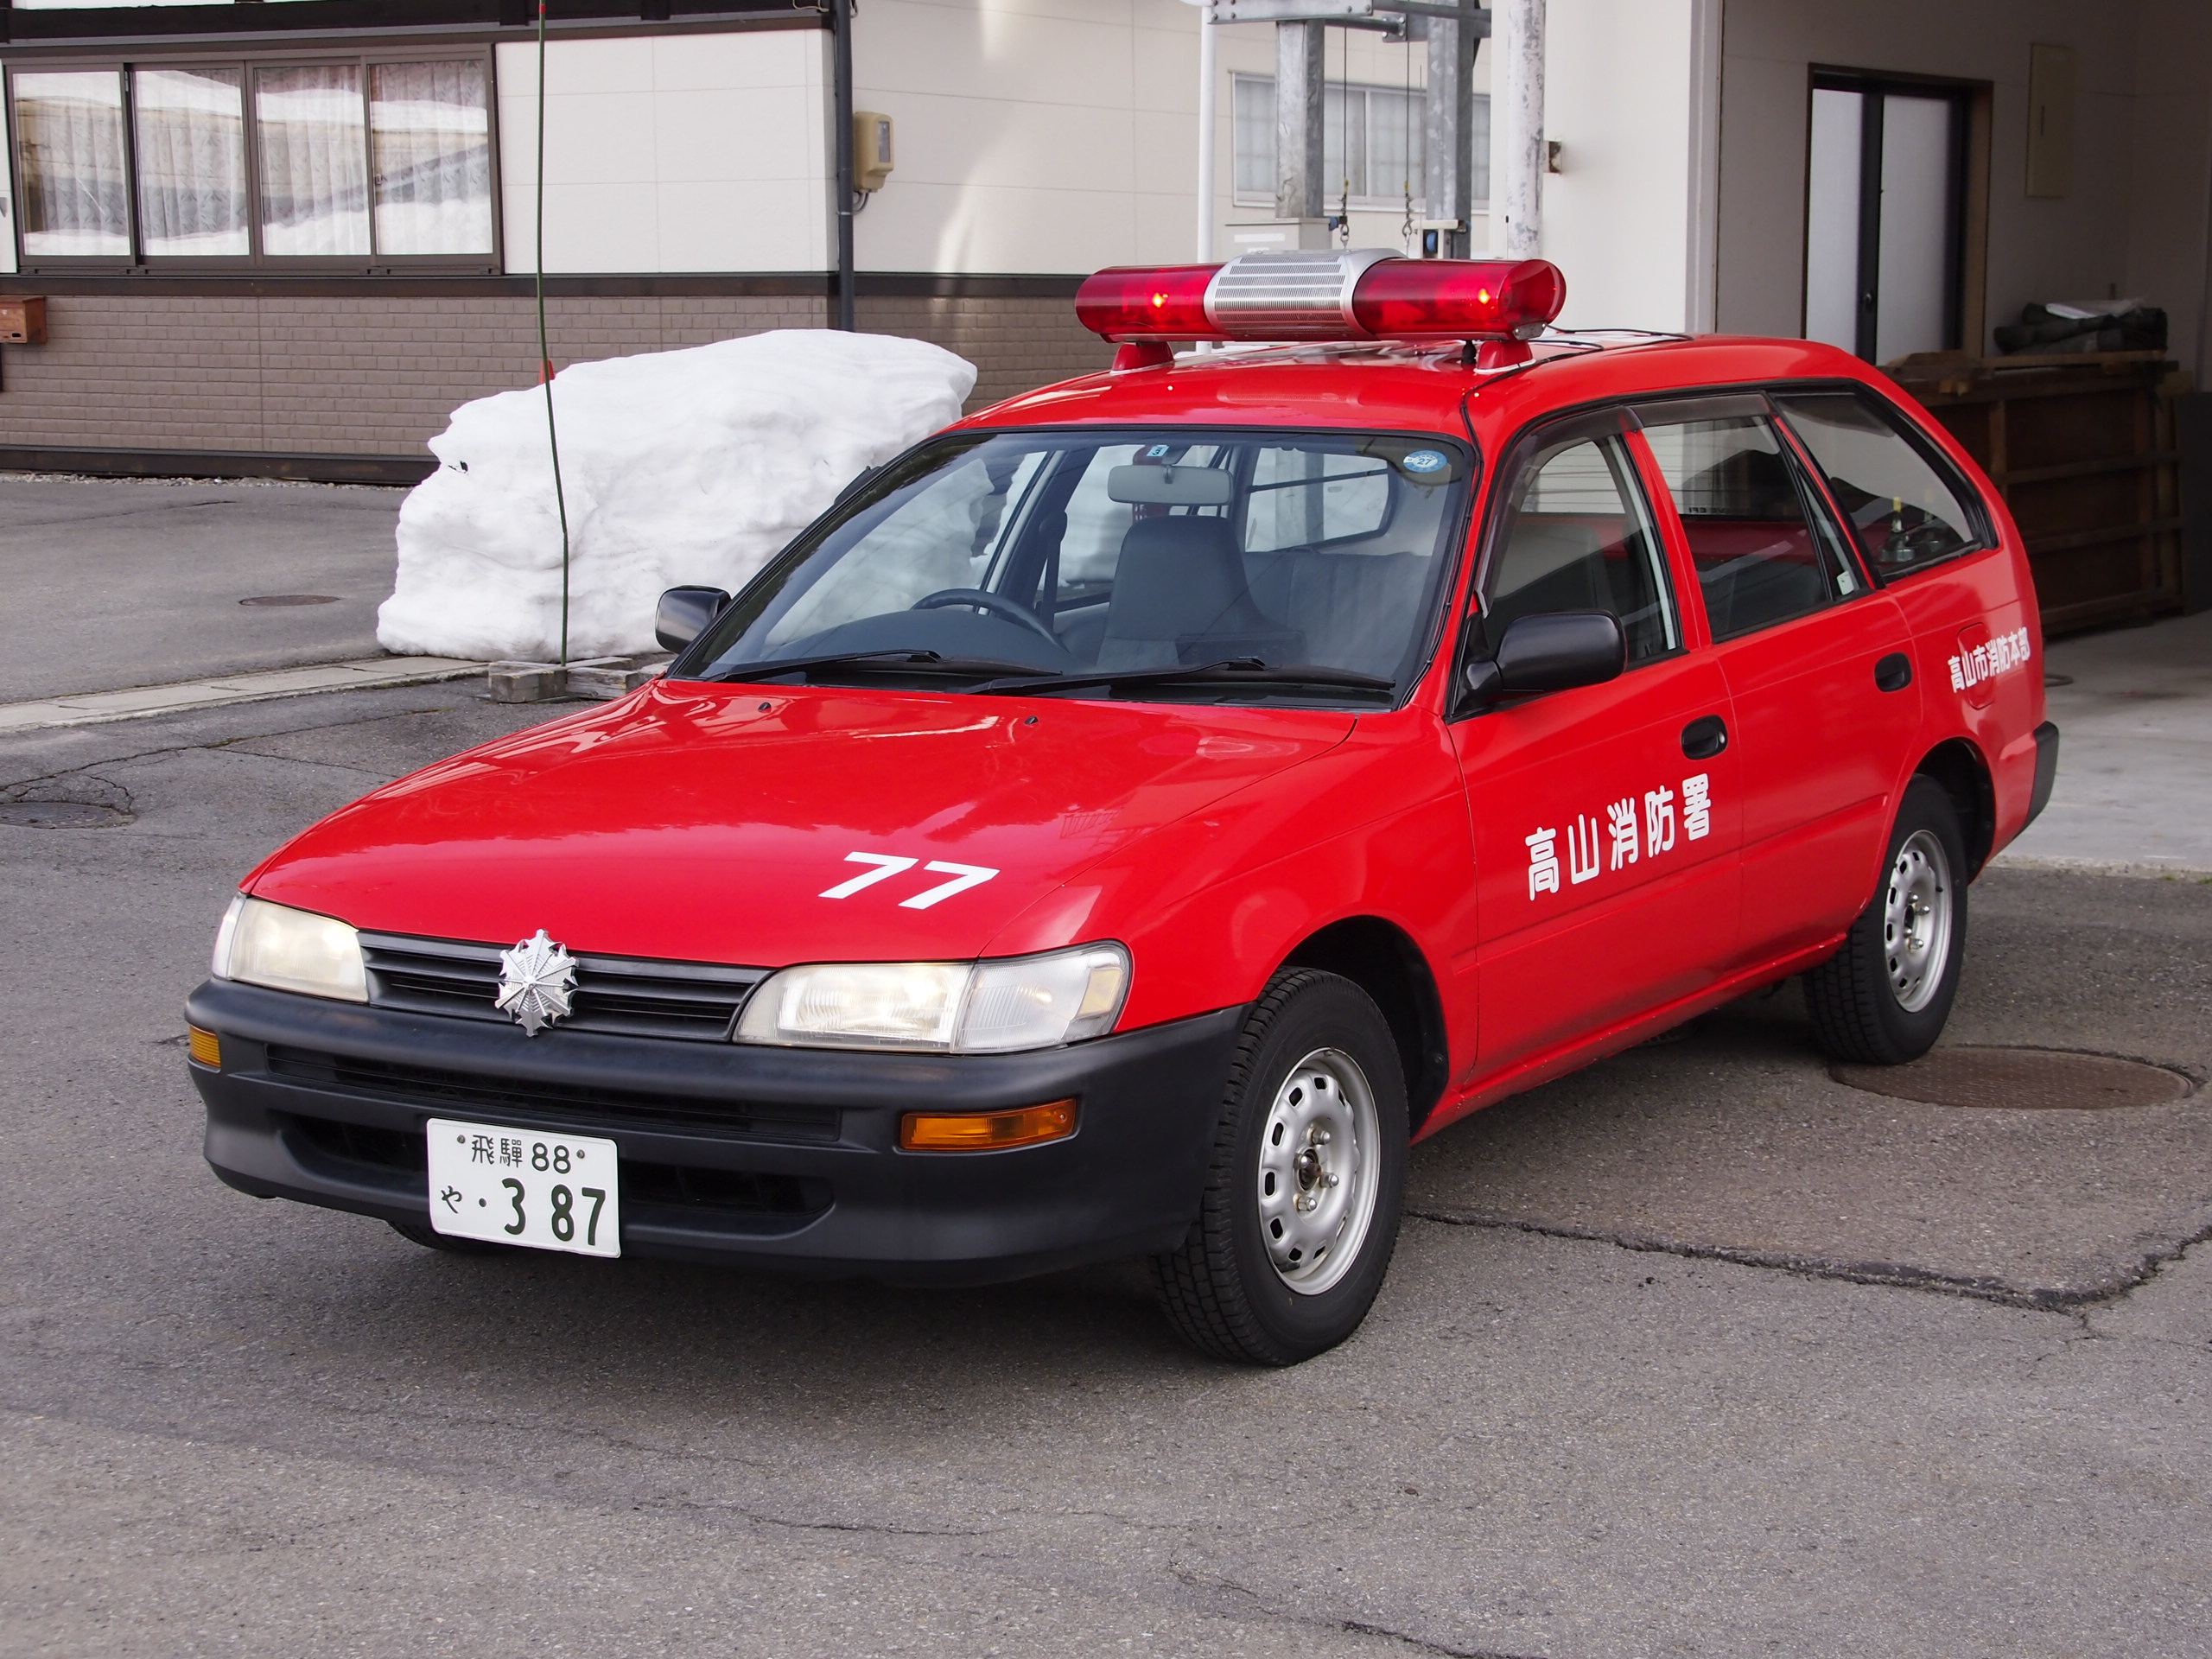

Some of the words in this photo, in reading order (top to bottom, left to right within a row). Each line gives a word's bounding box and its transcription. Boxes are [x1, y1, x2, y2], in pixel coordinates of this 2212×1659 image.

[1947, 626, 2031, 694] 高山市消防本部
[1524, 772, 1712, 901] 高山消防署
[817, 851, 1001, 910] 77
